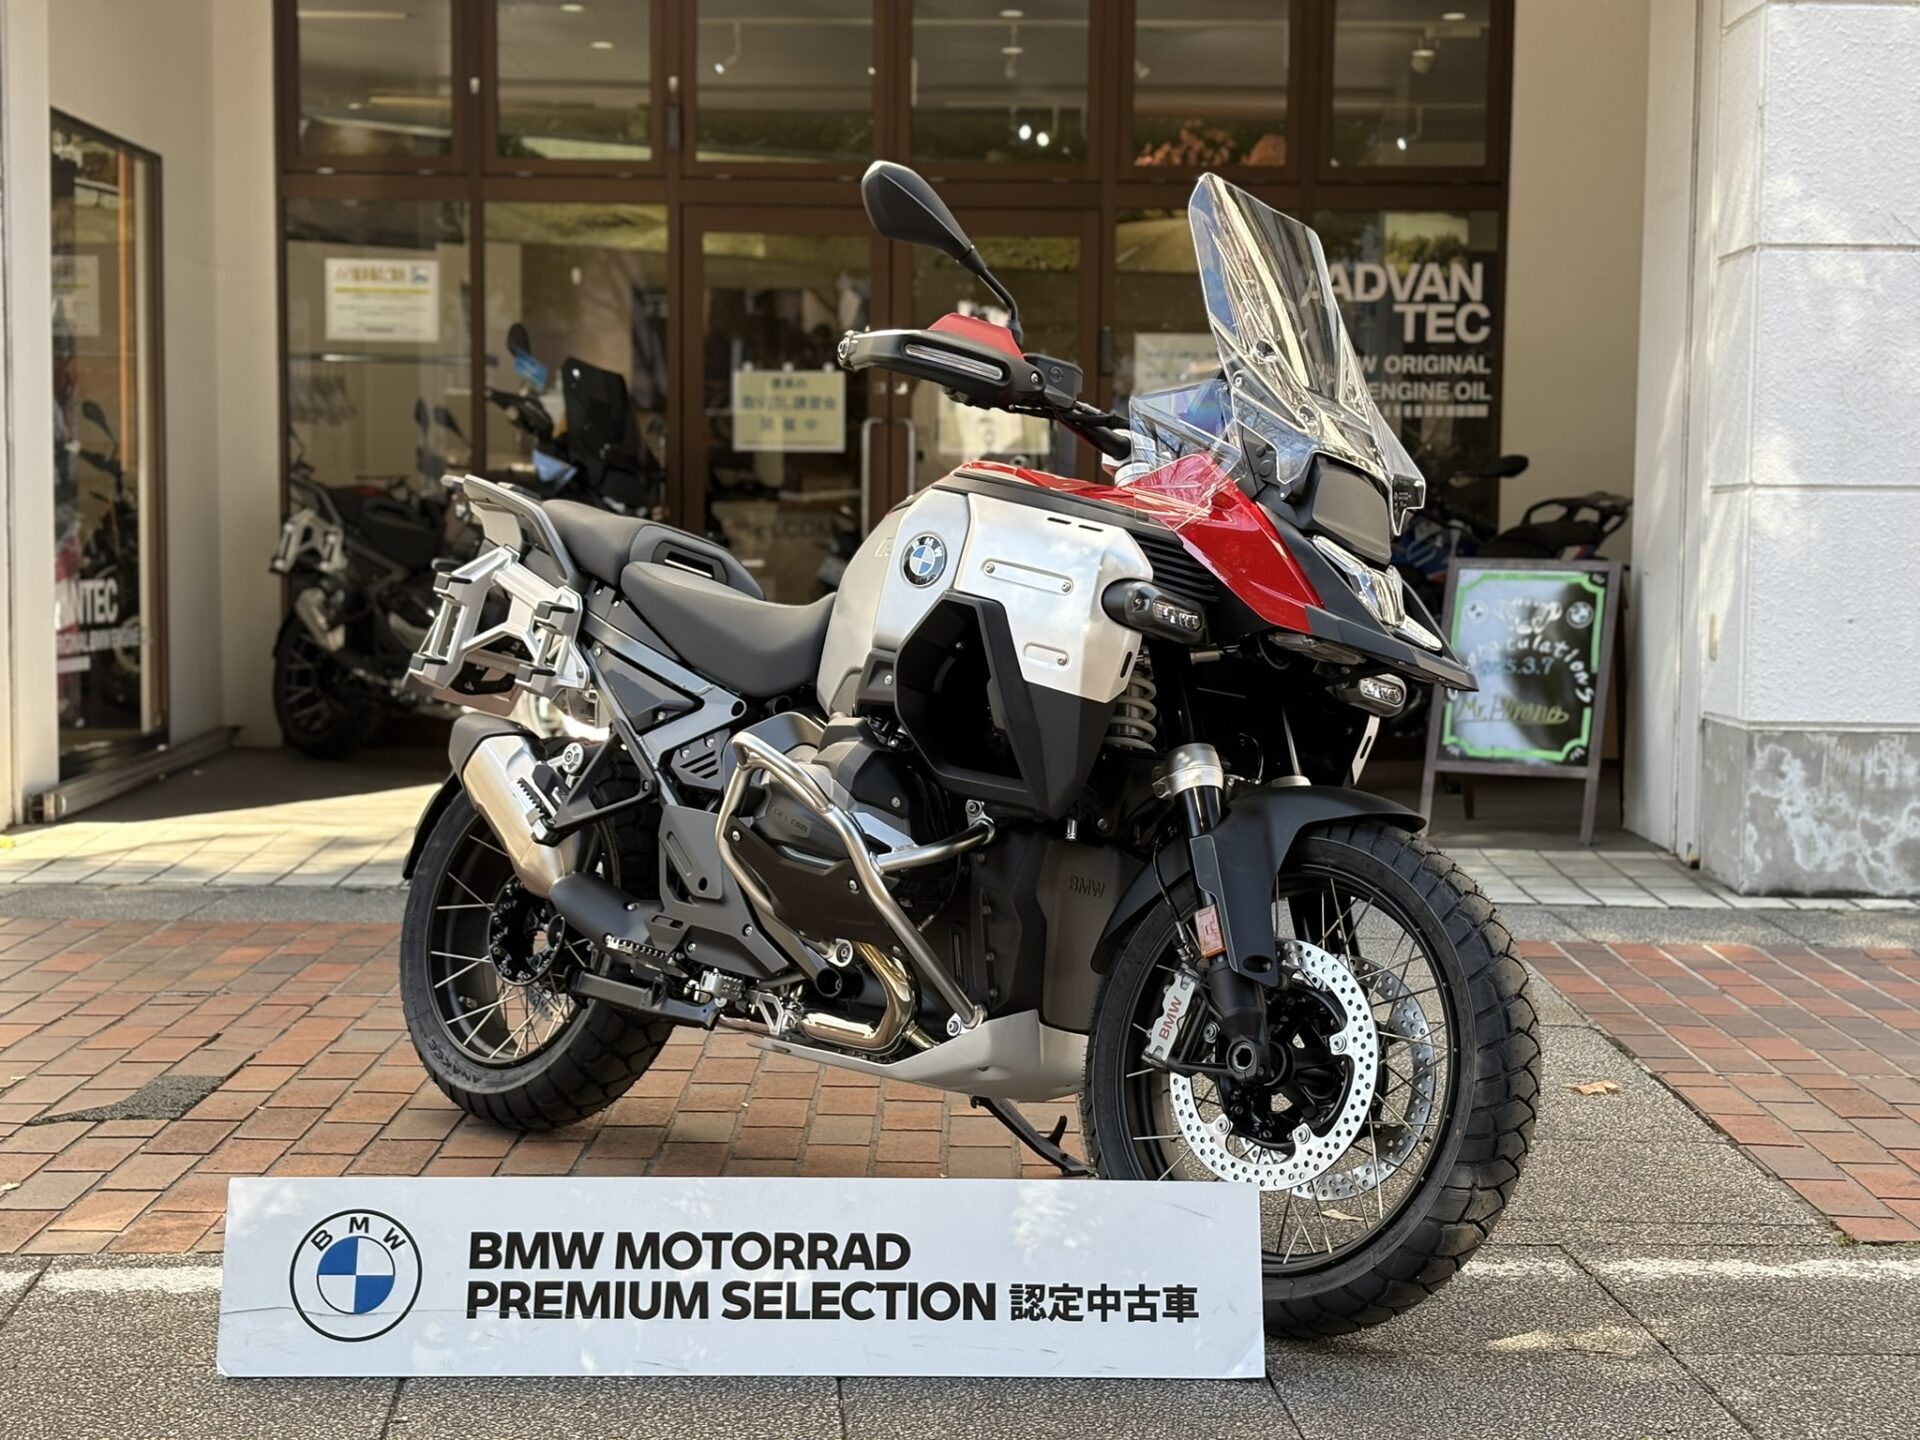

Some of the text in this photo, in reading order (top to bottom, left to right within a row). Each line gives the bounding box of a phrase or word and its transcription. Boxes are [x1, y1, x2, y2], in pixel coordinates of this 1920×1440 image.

[1328, 261, 1484, 302] ADVAN
[1392, 302, 1491, 344] TEC
[1383, 354, 1491, 375] ORIGINAL
[1453, 381, 1492, 401] OIL
[1069, 874, 1106, 899] BMW
[1158, 994, 1182, 1041] BMW
[469, 1231, 911, 1271] BMW MOTORRAD
[466, 1280, 1200, 1323] PREMIUM SELECTION 認定中古車
